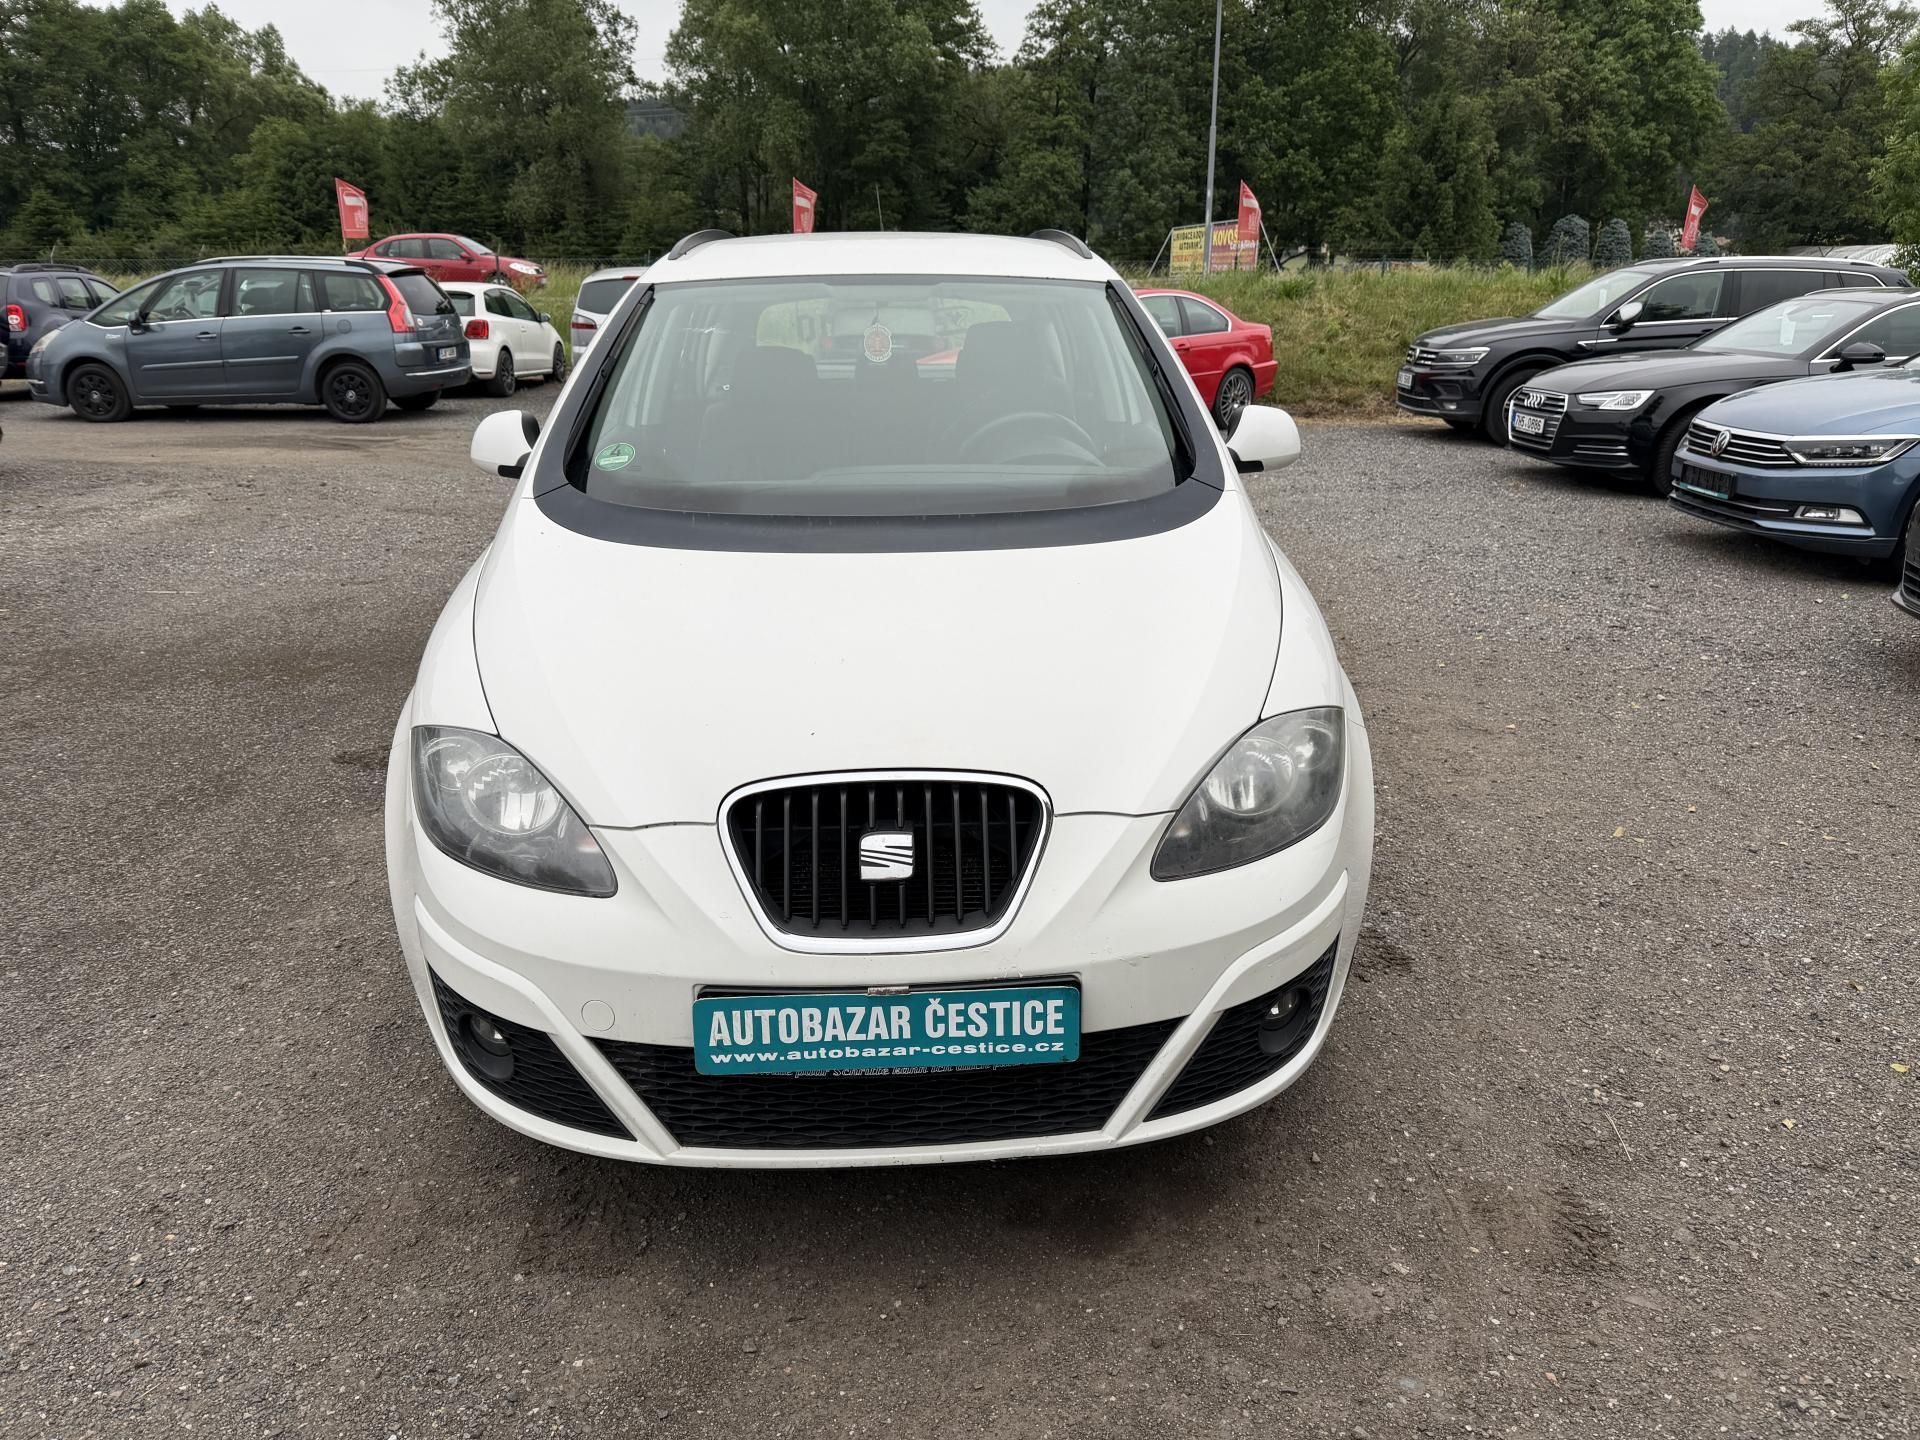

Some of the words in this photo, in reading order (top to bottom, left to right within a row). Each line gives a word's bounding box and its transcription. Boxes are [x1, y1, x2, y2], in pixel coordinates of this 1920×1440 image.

[1212, 225, 1238, 246] KOVOŠ
[709, 1005, 911, 1047] AUTOBAZAR
[925, 998, 1064, 1038] ČESTICE
[711, 1042, 1064, 1064] www.autobazar-cestice.cz
